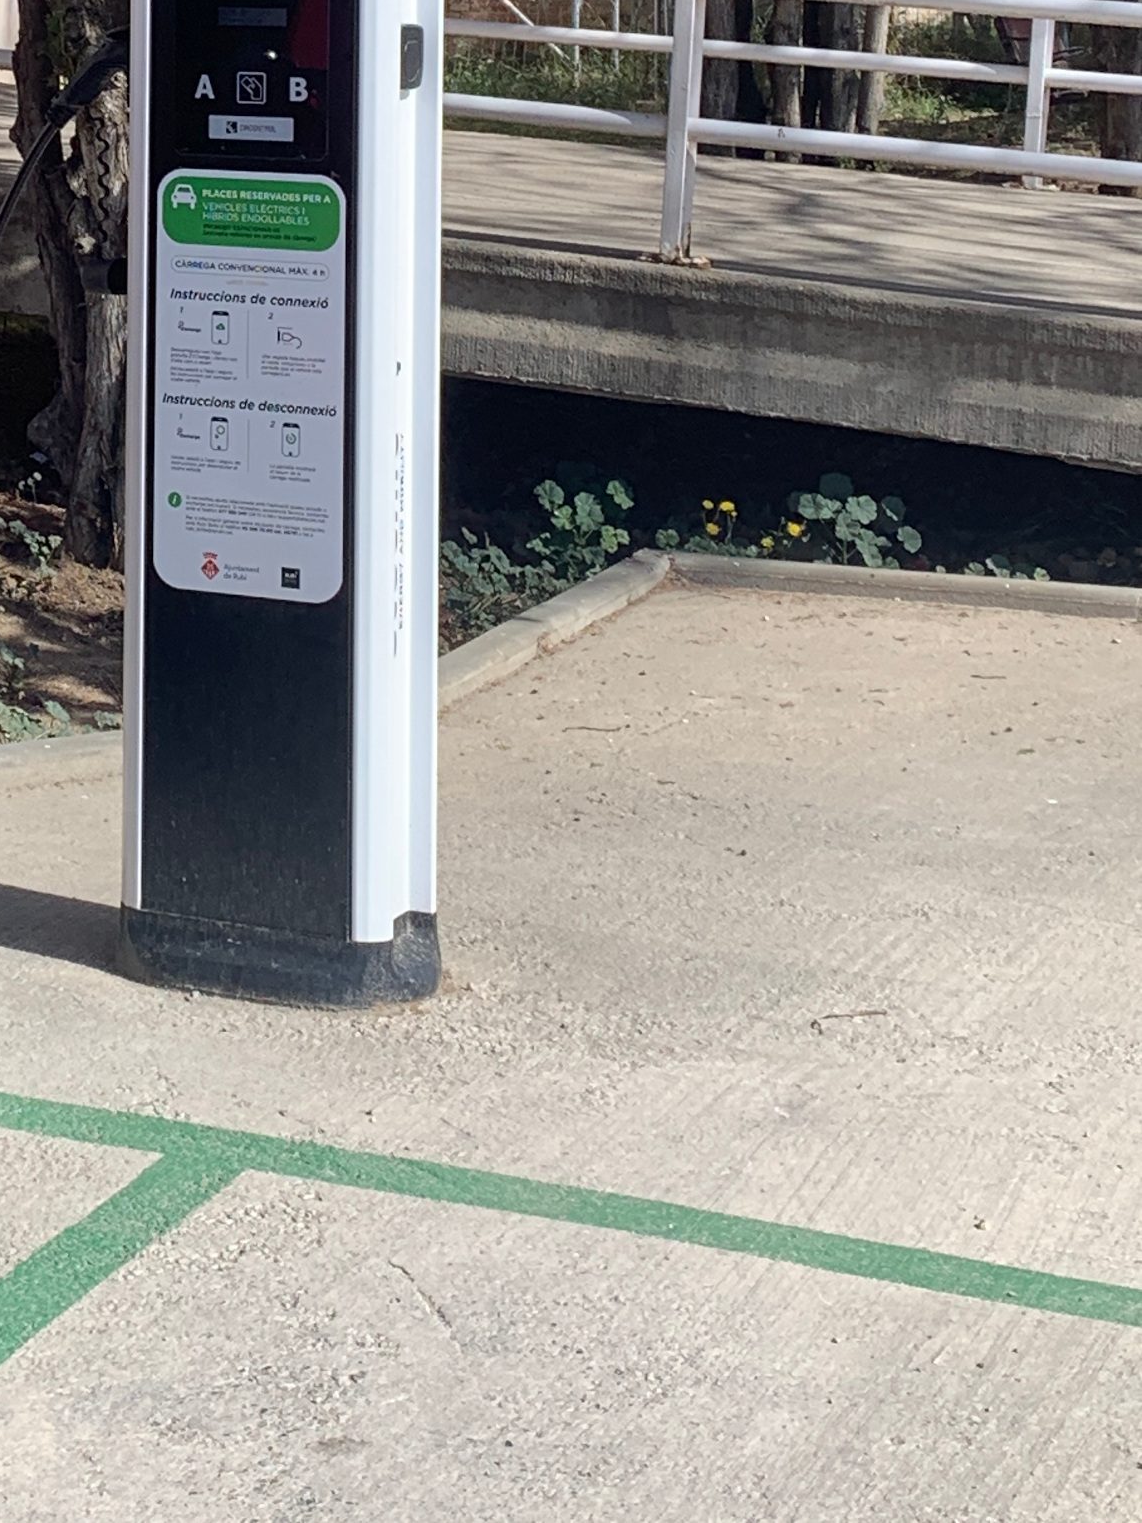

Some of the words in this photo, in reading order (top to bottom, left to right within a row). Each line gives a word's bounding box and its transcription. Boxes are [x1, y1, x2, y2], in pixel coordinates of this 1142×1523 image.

[195, 74, 215, 100] A
[289, 76, 309, 103] B
[201, 189, 238, 199] PLACES
[239, 191, 301, 202] RESERVADES
[302, 193, 321, 203] PER
[323, 194, 332, 204] A
[241, 213, 310, 226] ENDOLLABLES
[217, 262, 286, 275] CONVENCIONAL
[169, 288, 247, 305] Instruccions
[249, 293, 267, 306] de
[269, 296, 330, 310] connexió
[161, 392, 236, 410] Instruccions
[238, 398, 256, 411] de
[258, 401, 338, 417] desconnexió
